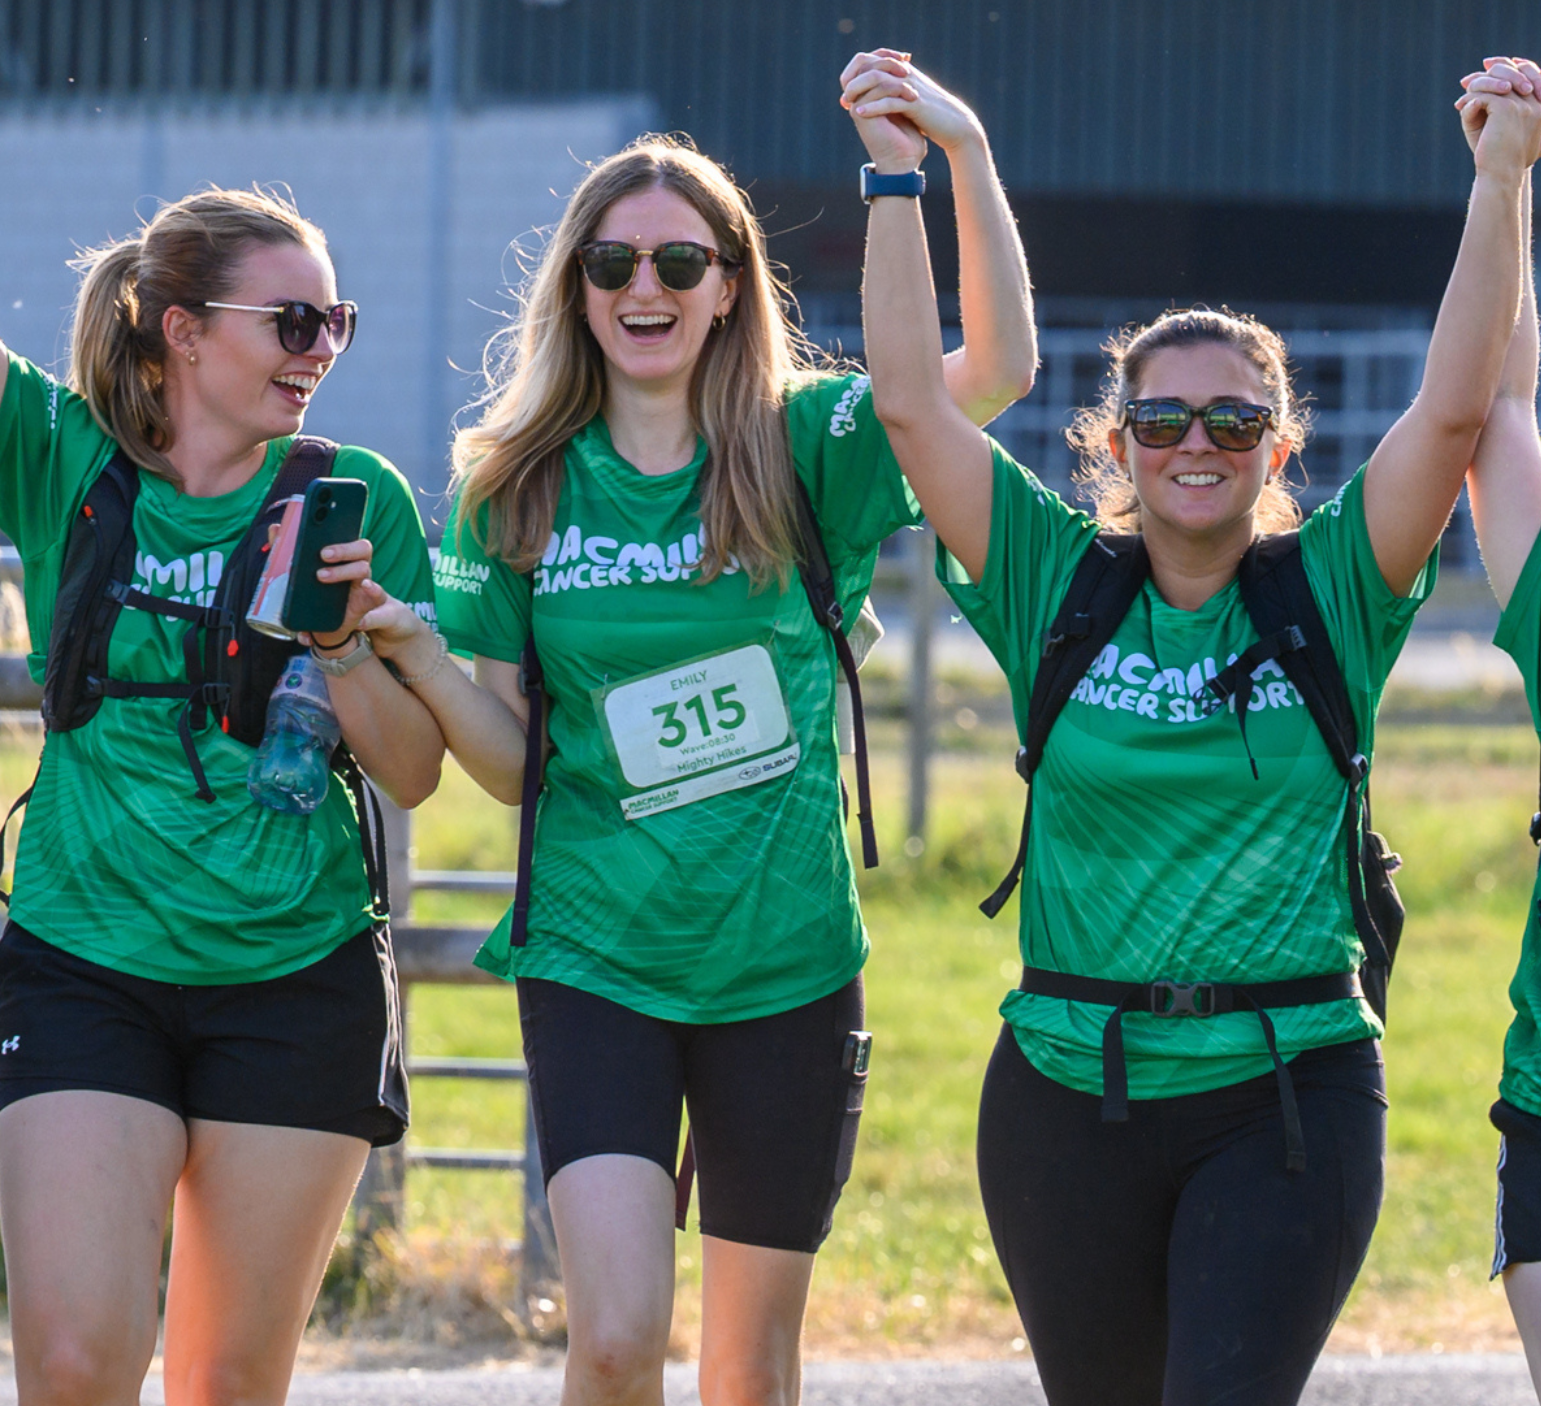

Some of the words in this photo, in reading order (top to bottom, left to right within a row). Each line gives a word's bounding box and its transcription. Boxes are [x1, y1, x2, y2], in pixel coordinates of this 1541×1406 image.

[670, 670, 708, 691] EMILY
[1069, 677, 1159, 720] ANCER
[652, 683, 746, 748] 315
[679, 733, 736, 756] Wave:08:30
[677, 754, 715, 773] Mighty
[717, 745, 747, 761] Hikes
[628, 789, 679, 810] MACMILLAN
